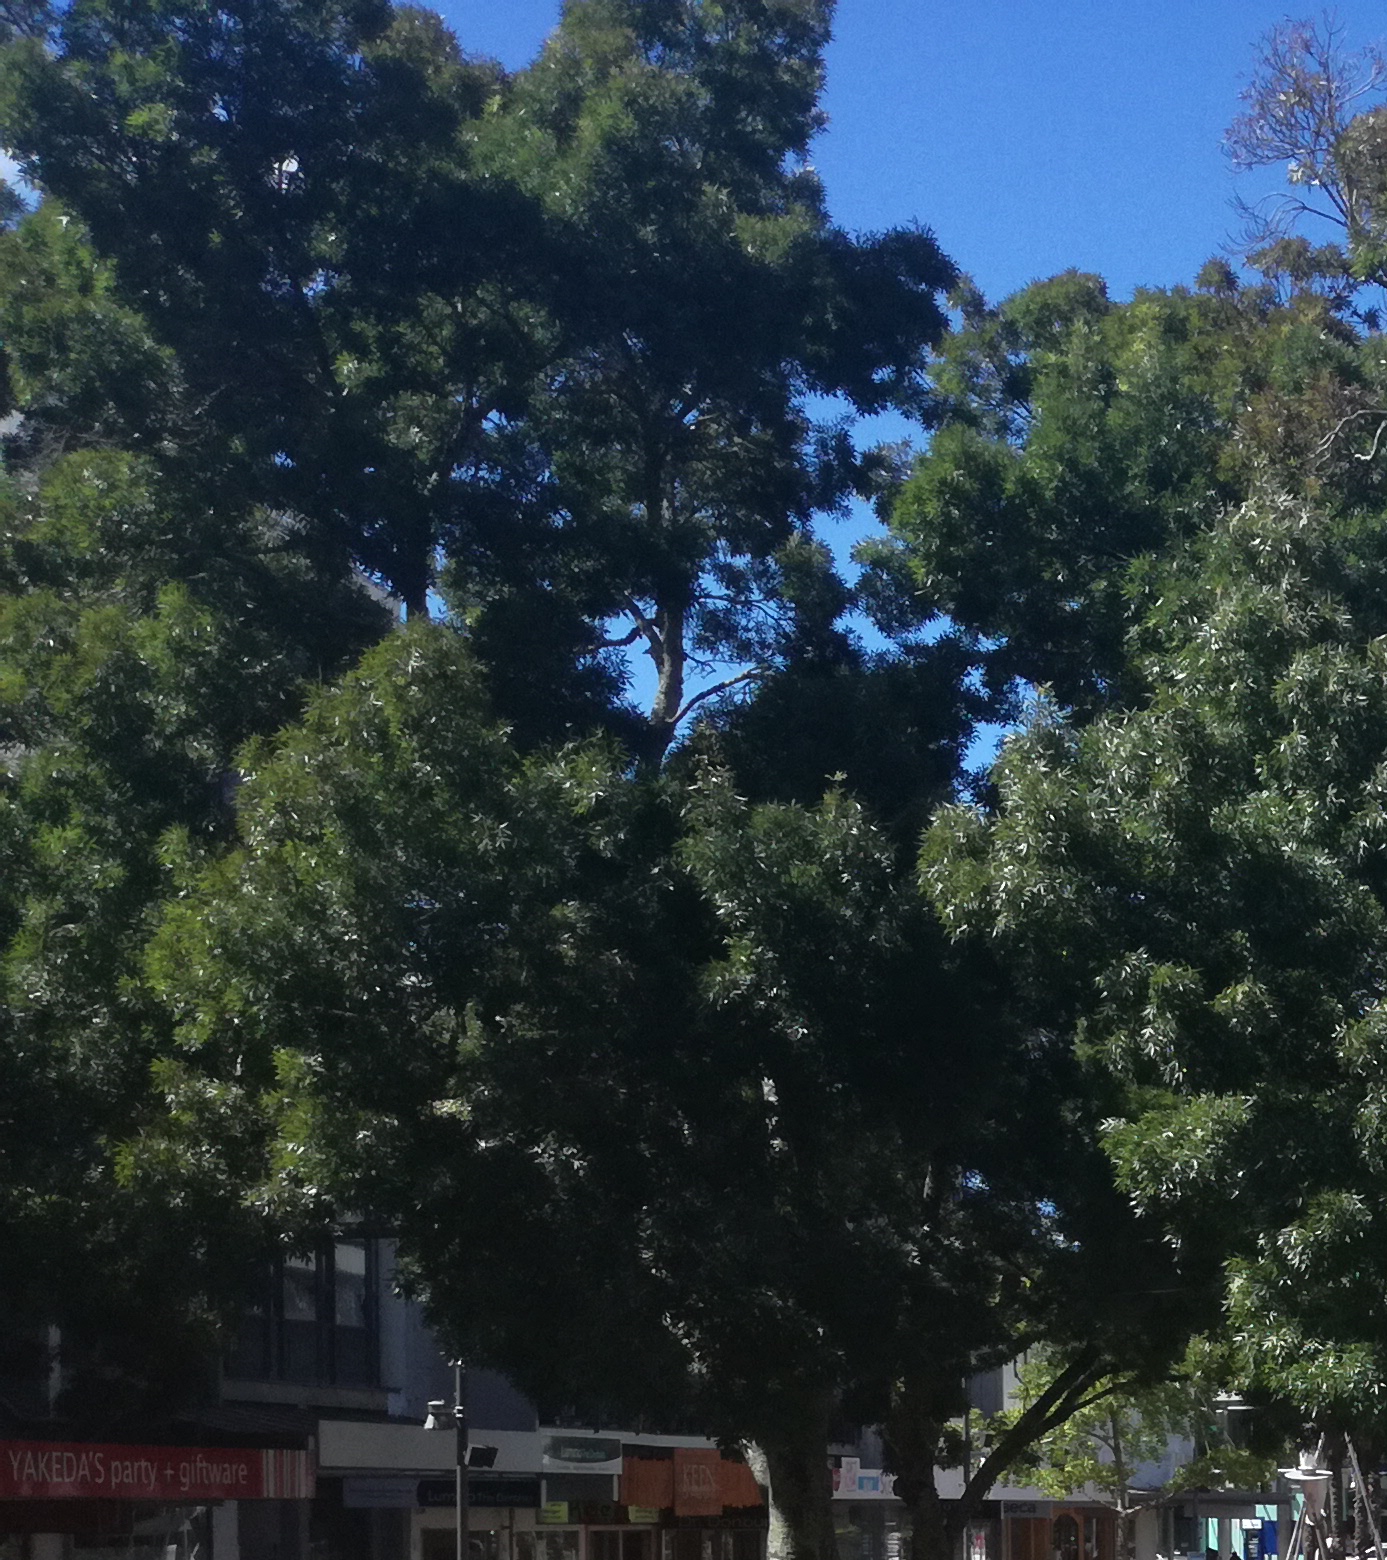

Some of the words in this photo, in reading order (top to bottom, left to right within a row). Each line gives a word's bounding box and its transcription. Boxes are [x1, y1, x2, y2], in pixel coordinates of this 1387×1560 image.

[9, 1448, 105, 1484] YAKEDA'S
[111, 1456, 157, 1488] party
[164, 1462, 175, 1482] +
[179, 1454, 248, 1491] giftware
[427, 1489, 476, 1503] Lumo
